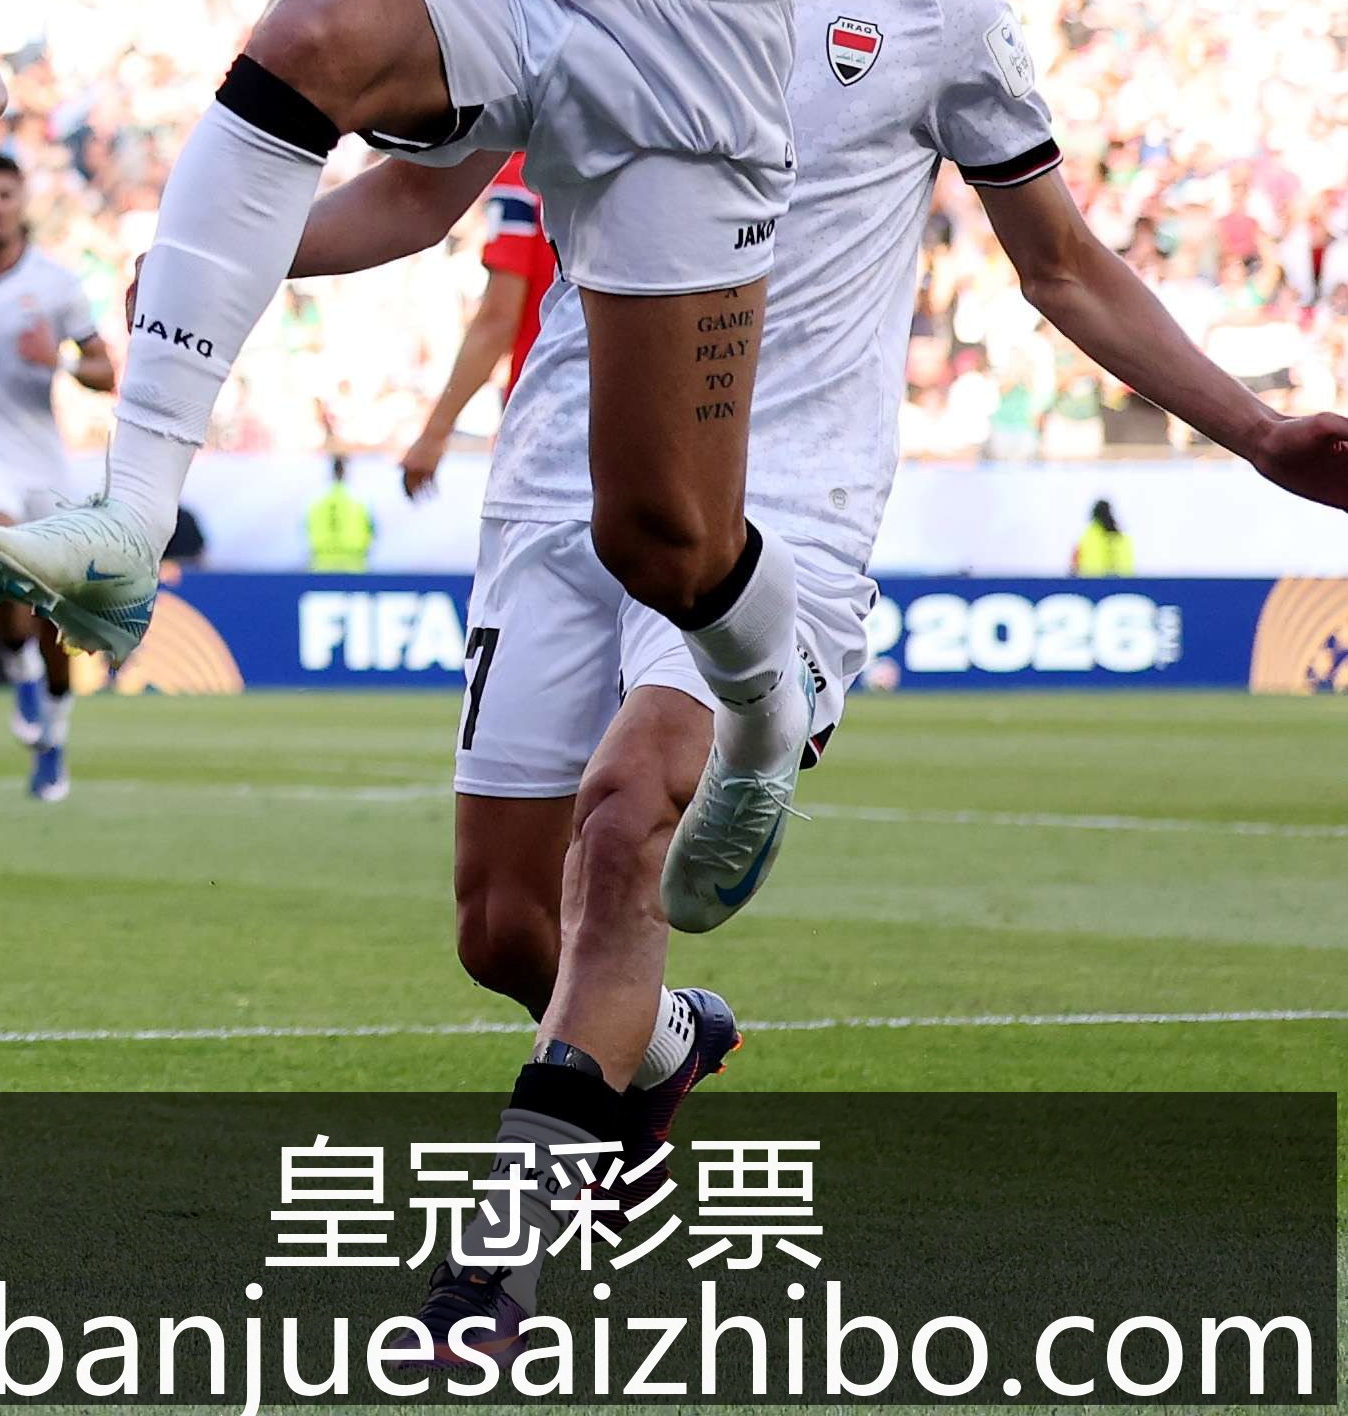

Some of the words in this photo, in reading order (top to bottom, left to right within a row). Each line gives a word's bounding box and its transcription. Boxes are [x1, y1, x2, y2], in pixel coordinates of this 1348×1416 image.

[841, 21, 873, 34] IRAQ
[734, 218, 775, 250] JAKO
[697, 309, 754, 333] GAME
[134, 314, 214, 359] JAKO
[696, 340, 749, 363] PLAY
[705, 372, 735, 390] TO
[695, 400, 736, 424] WIN
[298, 589, 467, 673] FIFA
[903, 592, 1157, 673] 2026
[461, 626, 501, 751] 7
